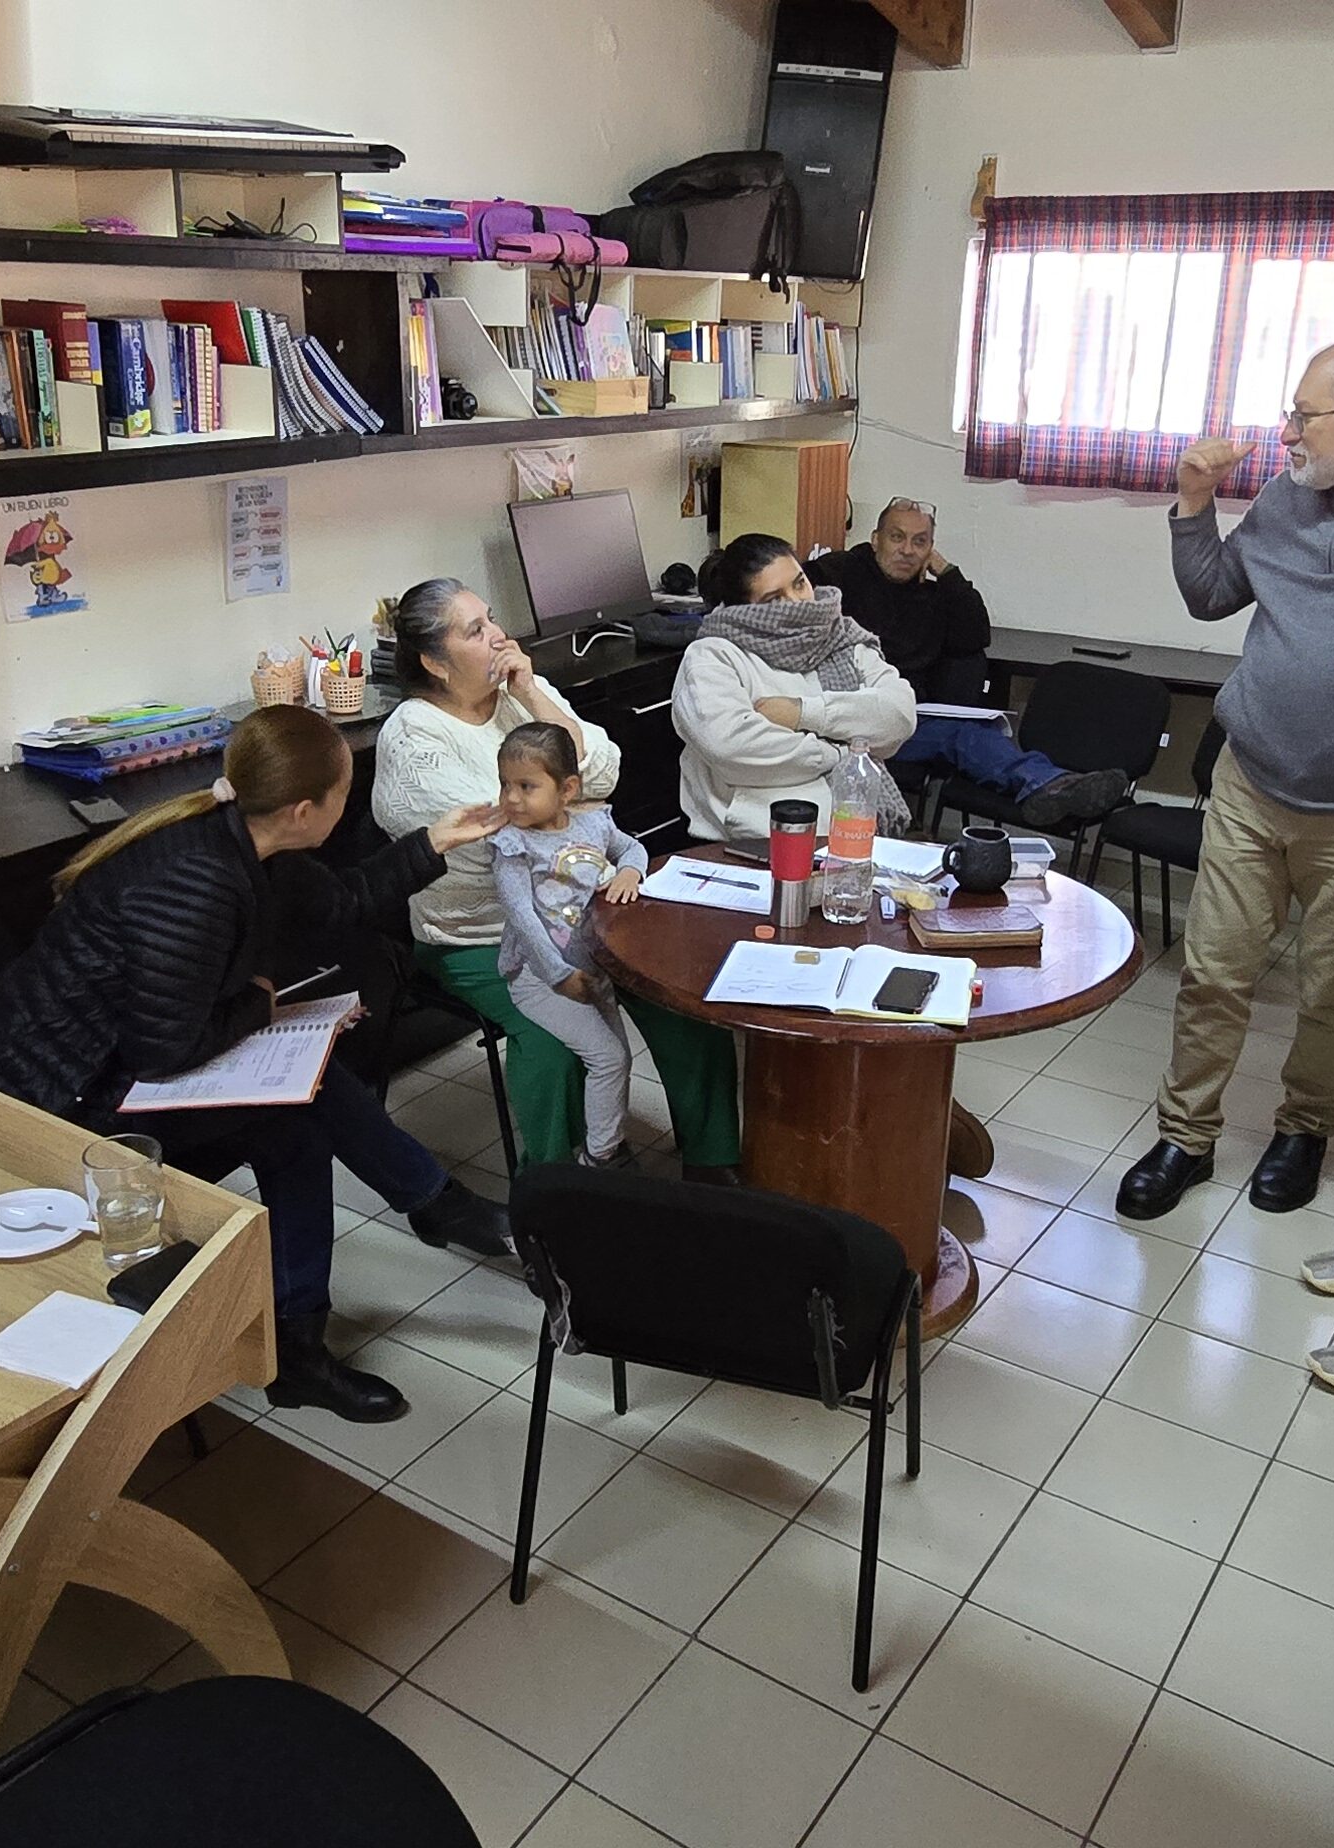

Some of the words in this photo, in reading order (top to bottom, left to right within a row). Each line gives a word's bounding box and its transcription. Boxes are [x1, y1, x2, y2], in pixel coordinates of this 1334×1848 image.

[132, 337, 146, 406] Cambridge
[1, 502, 16, 513] UN
[17, 499, 42, 512] BUEN
[44, 496, 69, 509] LIBRO
